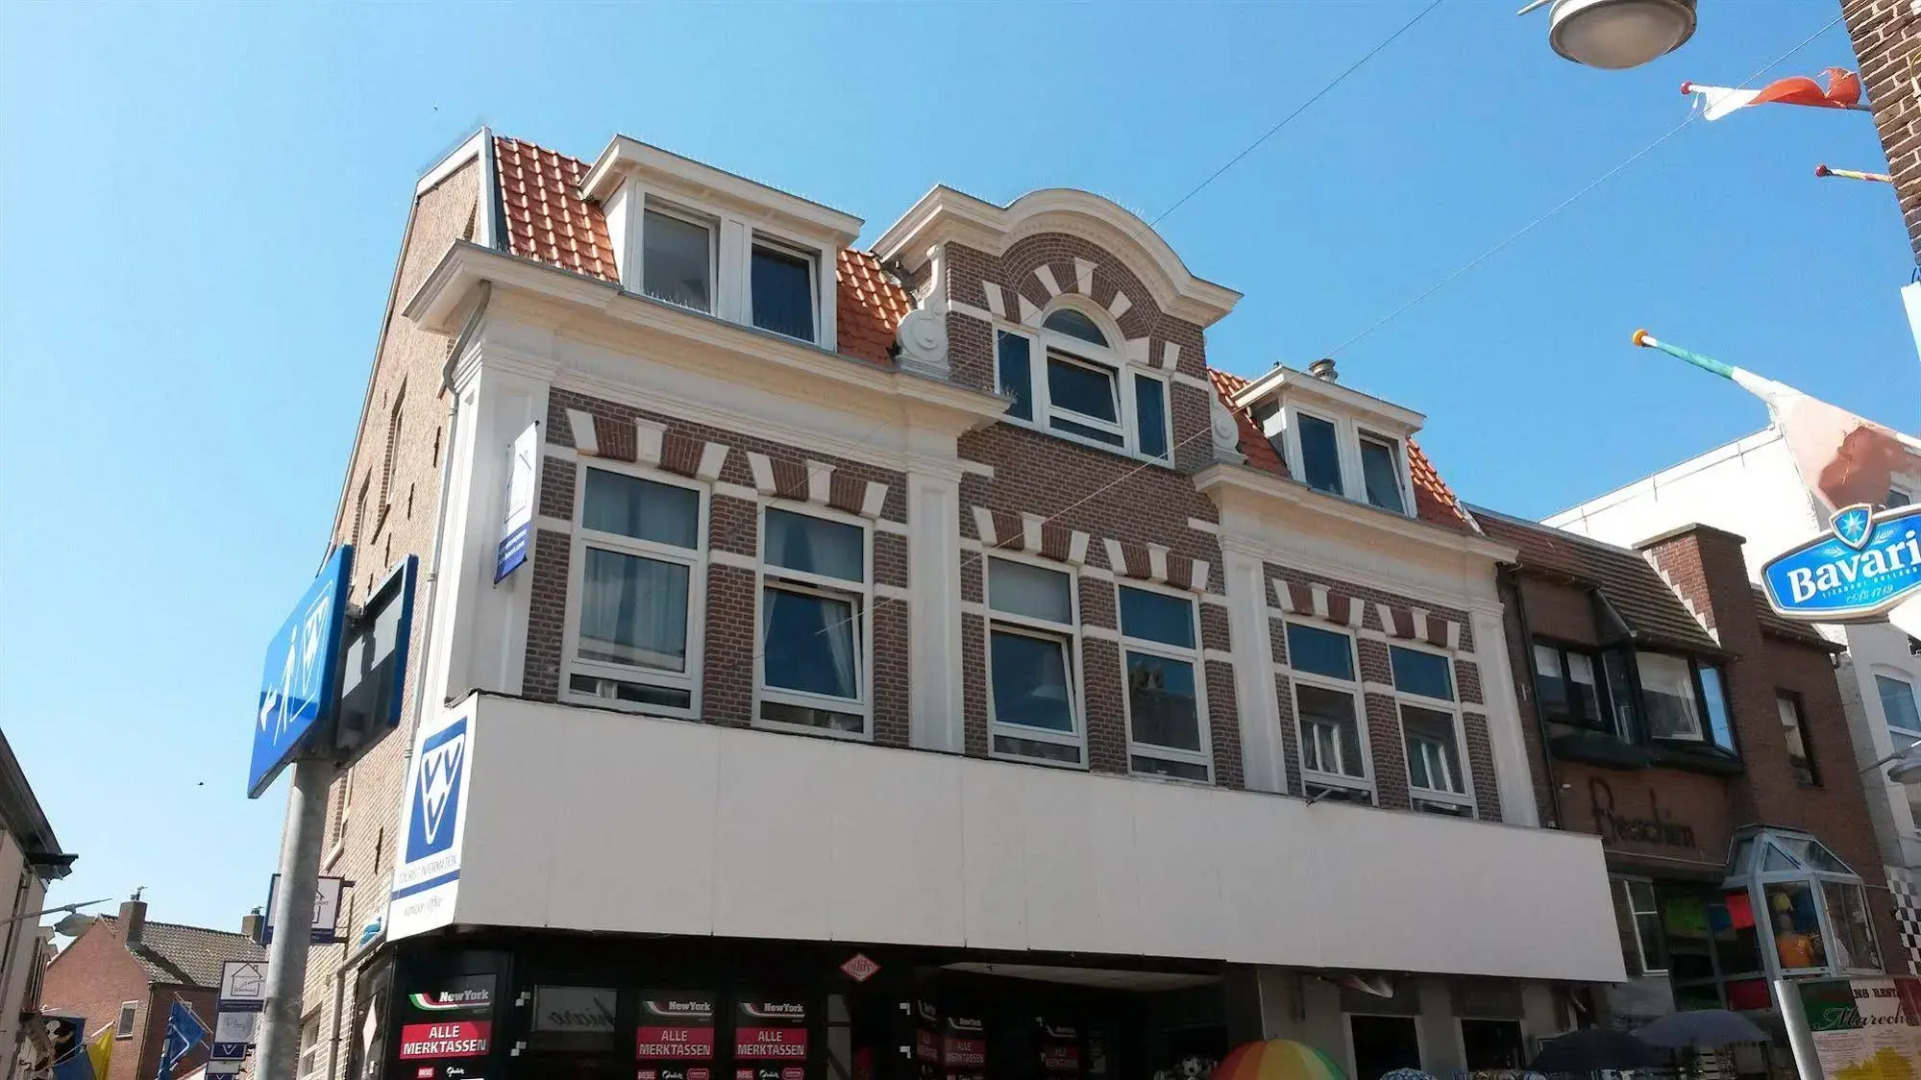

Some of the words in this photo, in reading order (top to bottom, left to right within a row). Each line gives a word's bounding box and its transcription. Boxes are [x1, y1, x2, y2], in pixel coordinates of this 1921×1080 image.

[429, 1025, 460, 1039] ALLE
[661, 1030, 688, 1042] ALLE
[758, 1031, 783, 1042] ALLE
[403, 1038, 487, 1055] MERKTASSEN
[639, 1044, 711, 1056] MERKTASSEN
[737, 1044, 805, 1056] MERKTASSEN
